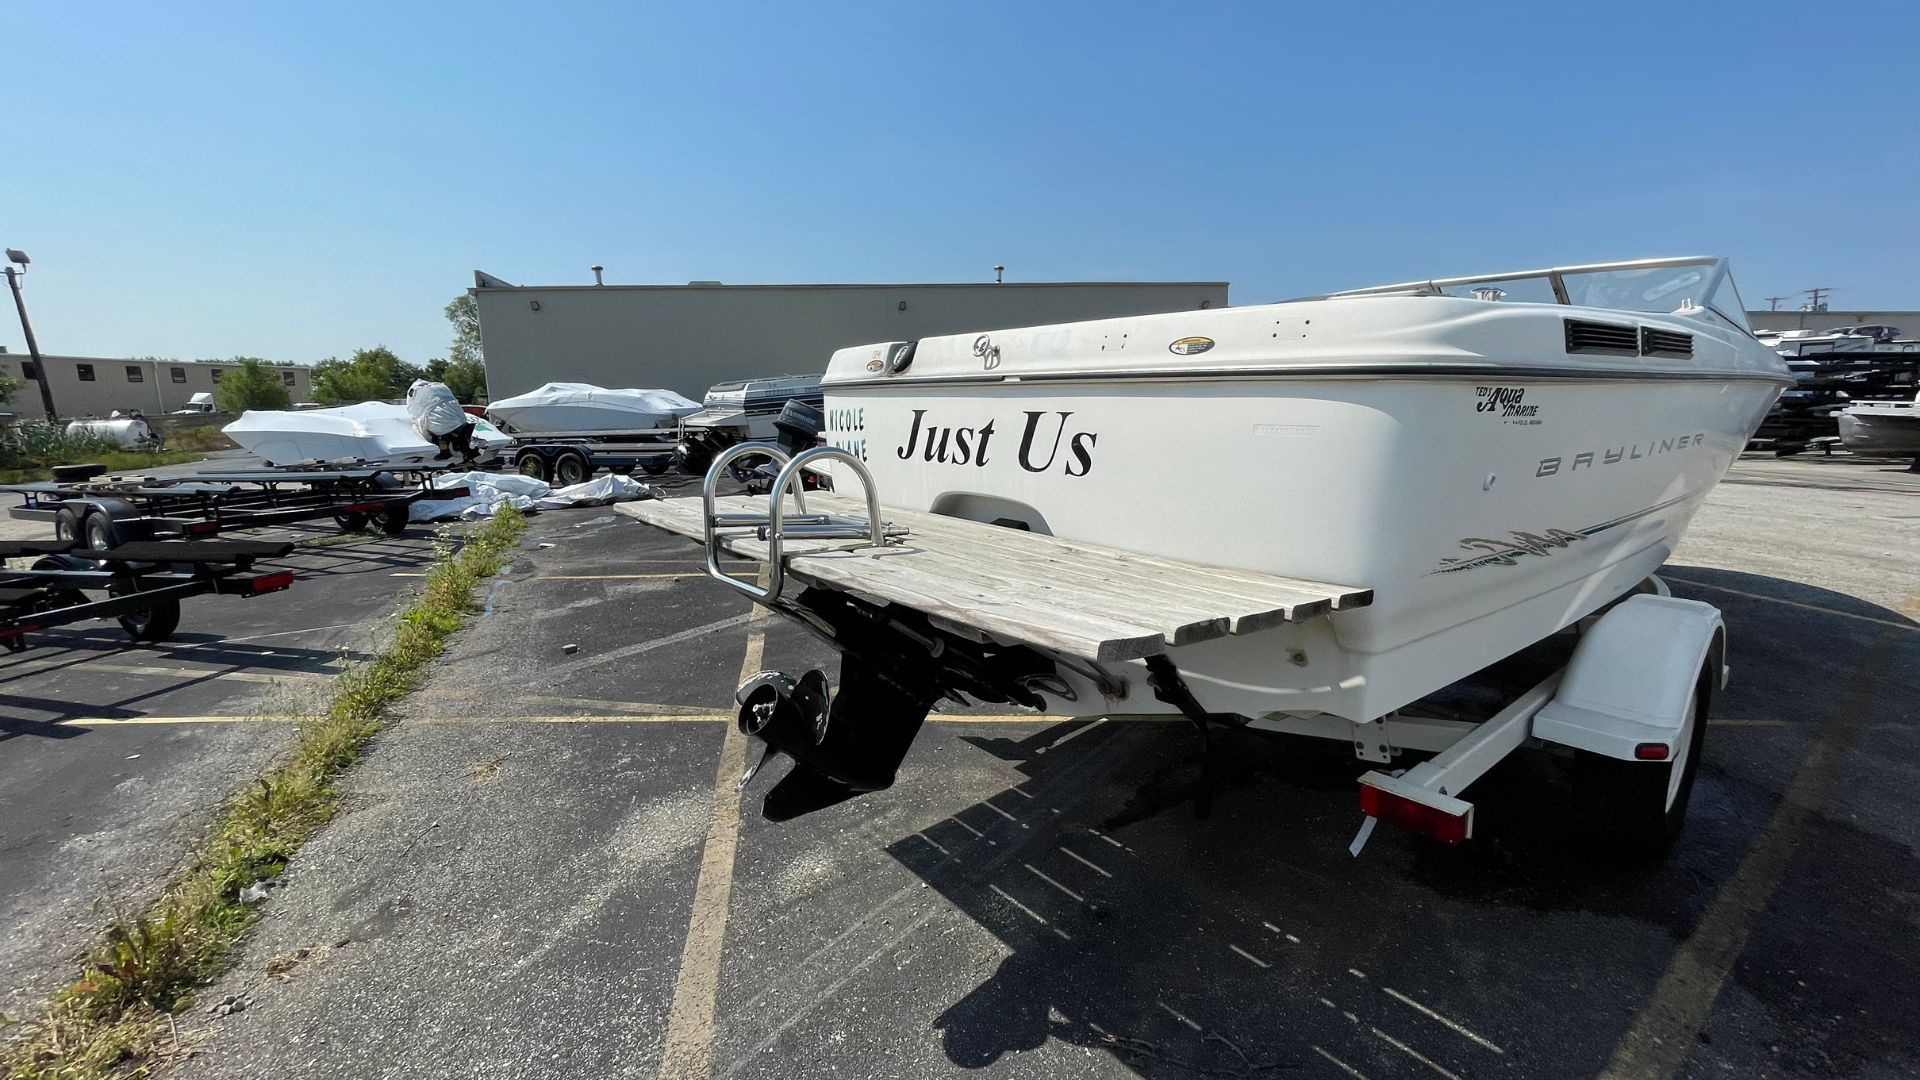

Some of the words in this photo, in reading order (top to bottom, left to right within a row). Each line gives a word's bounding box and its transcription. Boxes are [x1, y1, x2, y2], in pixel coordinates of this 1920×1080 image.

[830, 407, 864, 432] NICOLE
[897, 409, 995, 467] Just
[1018, 410, 1098, 477] Us
[1536, 433, 1705, 478] BAYLINER
